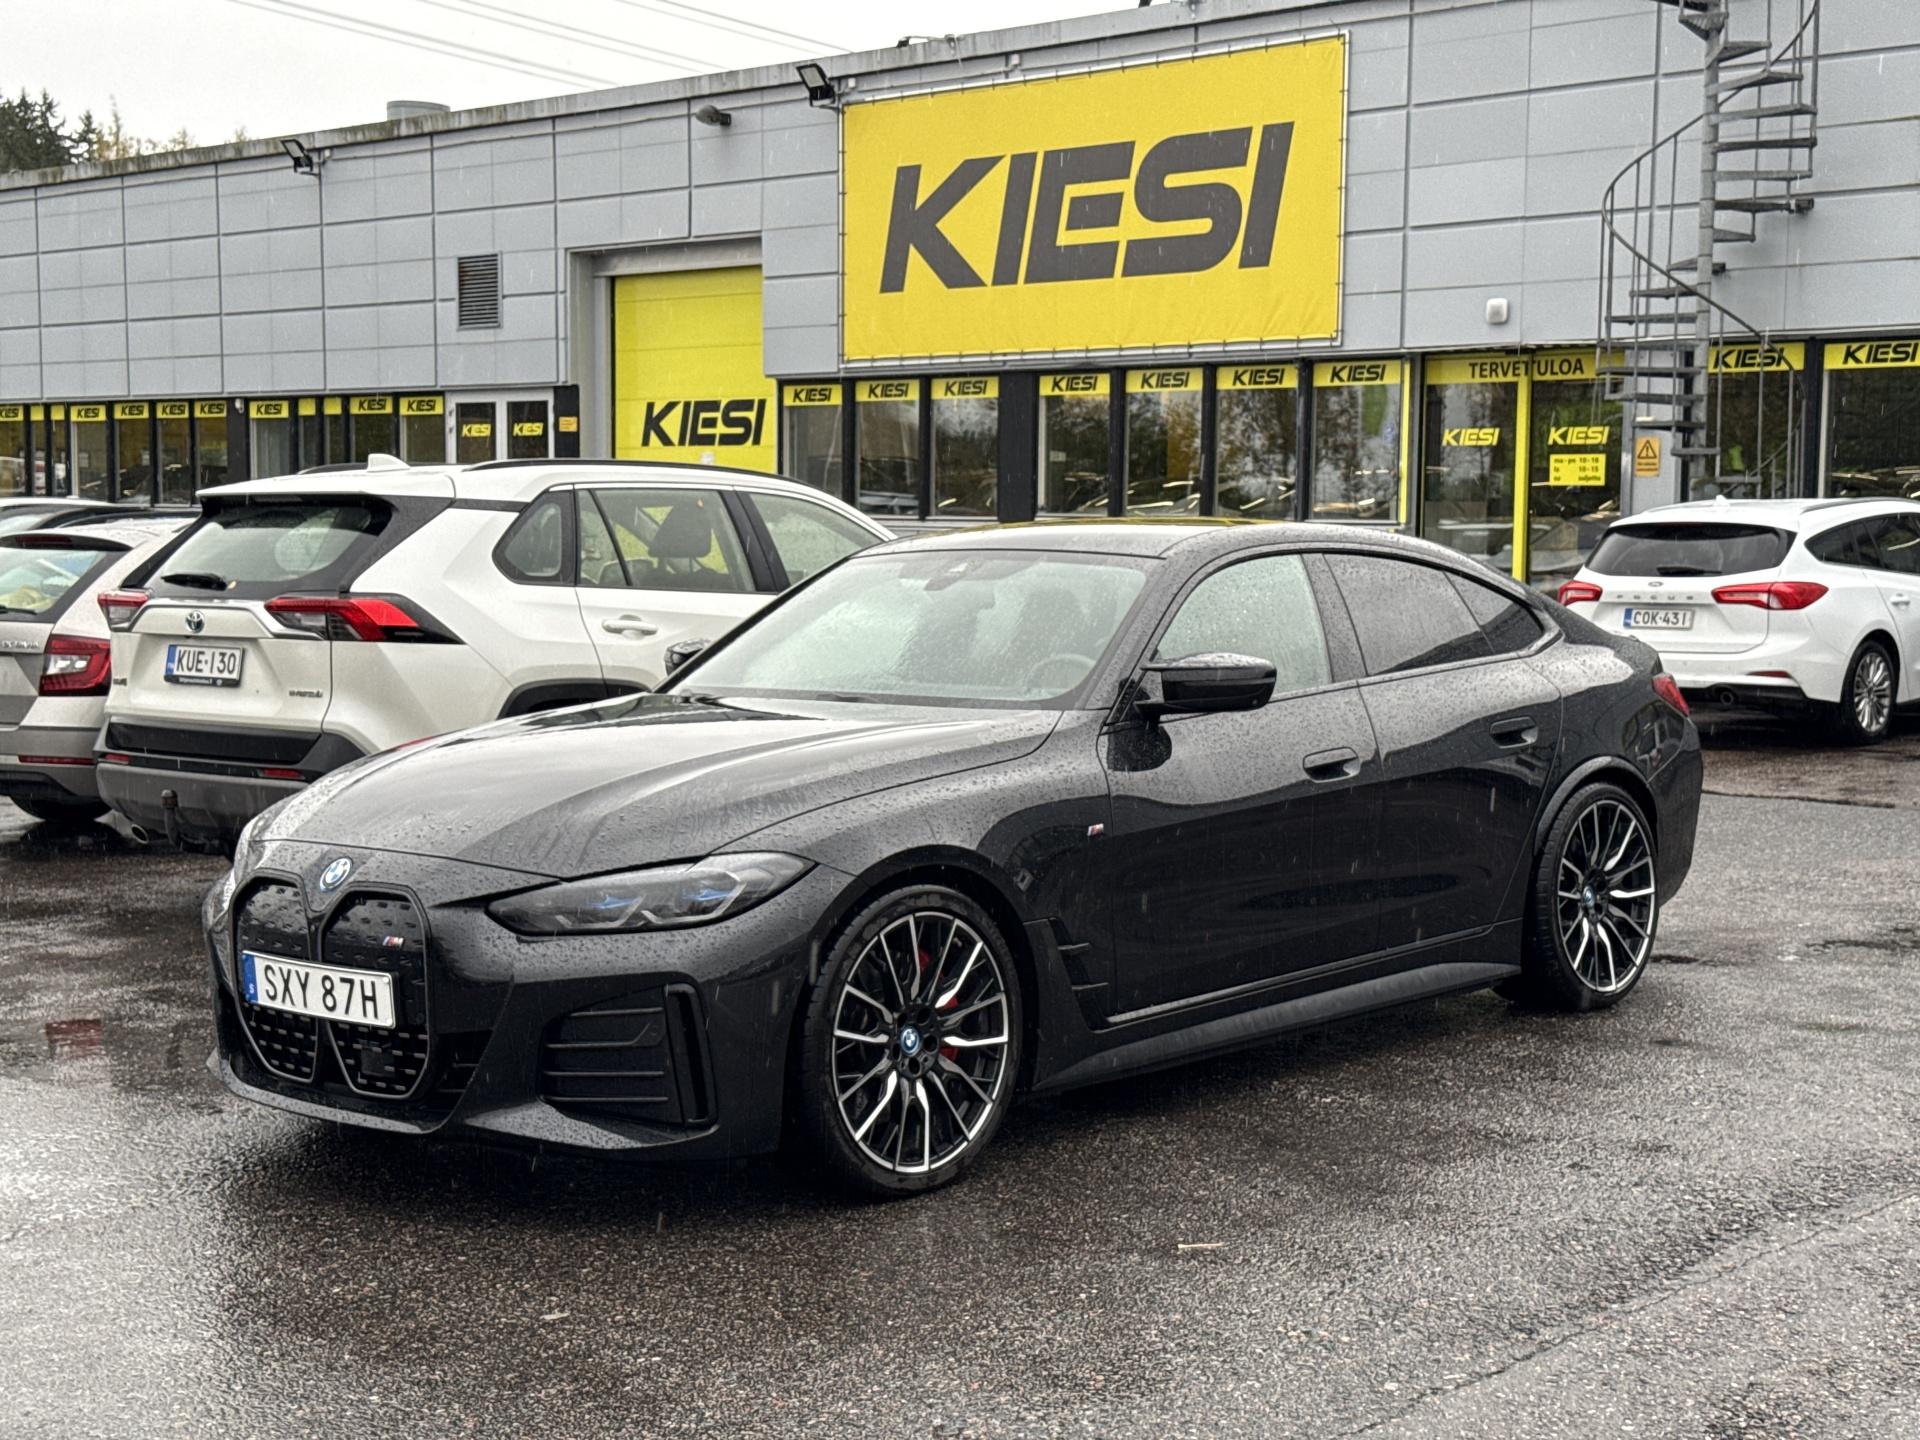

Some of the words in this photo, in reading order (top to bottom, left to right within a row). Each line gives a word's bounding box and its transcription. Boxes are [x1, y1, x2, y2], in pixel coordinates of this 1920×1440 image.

[879, 121, 1295, 294] KIESI
[1713, 347, 1785, 369] KIESI
[1842, 342, 1920, 365] KIESI
[1232, 367, 1285, 387] KIESI
[1330, 362, 1386, 383] KIESI
[1468, 357, 1585, 379] TERVETULOA
[944, 379, 988, 397] KIESI
[1051, 375, 1098, 393] KIESI
[1140, 370, 1190, 390] KIESI
[792, 387, 832, 403] KIESI
[867, 382, 909, 398] KIESI
[77, 407, 100, 419] KIESI
[120, 405, 144, 417] KIESI
[161, 404, 186, 416] KIESI
[200, 403, 225, 415] KIESI
[256, 402, 282, 416] KIESI
[358, 398, 387, 411] KIESI
[407, 398, 436, 412] KIESI
[462, 423, 492, 438] KIESI
[513, 422, 544, 437] KIESI
[641, 398, 767, 448] KIESI
[1442, 427, 1500, 446] KIESI
[1548, 425, 1610, 446] KIESI
[1633, 611, 1687, 626] COK-431
[176, 649, 237, 675] KUE-130
[263, 964, 310, 1009] SXY
[321, 974, 379, 1020] 87H
